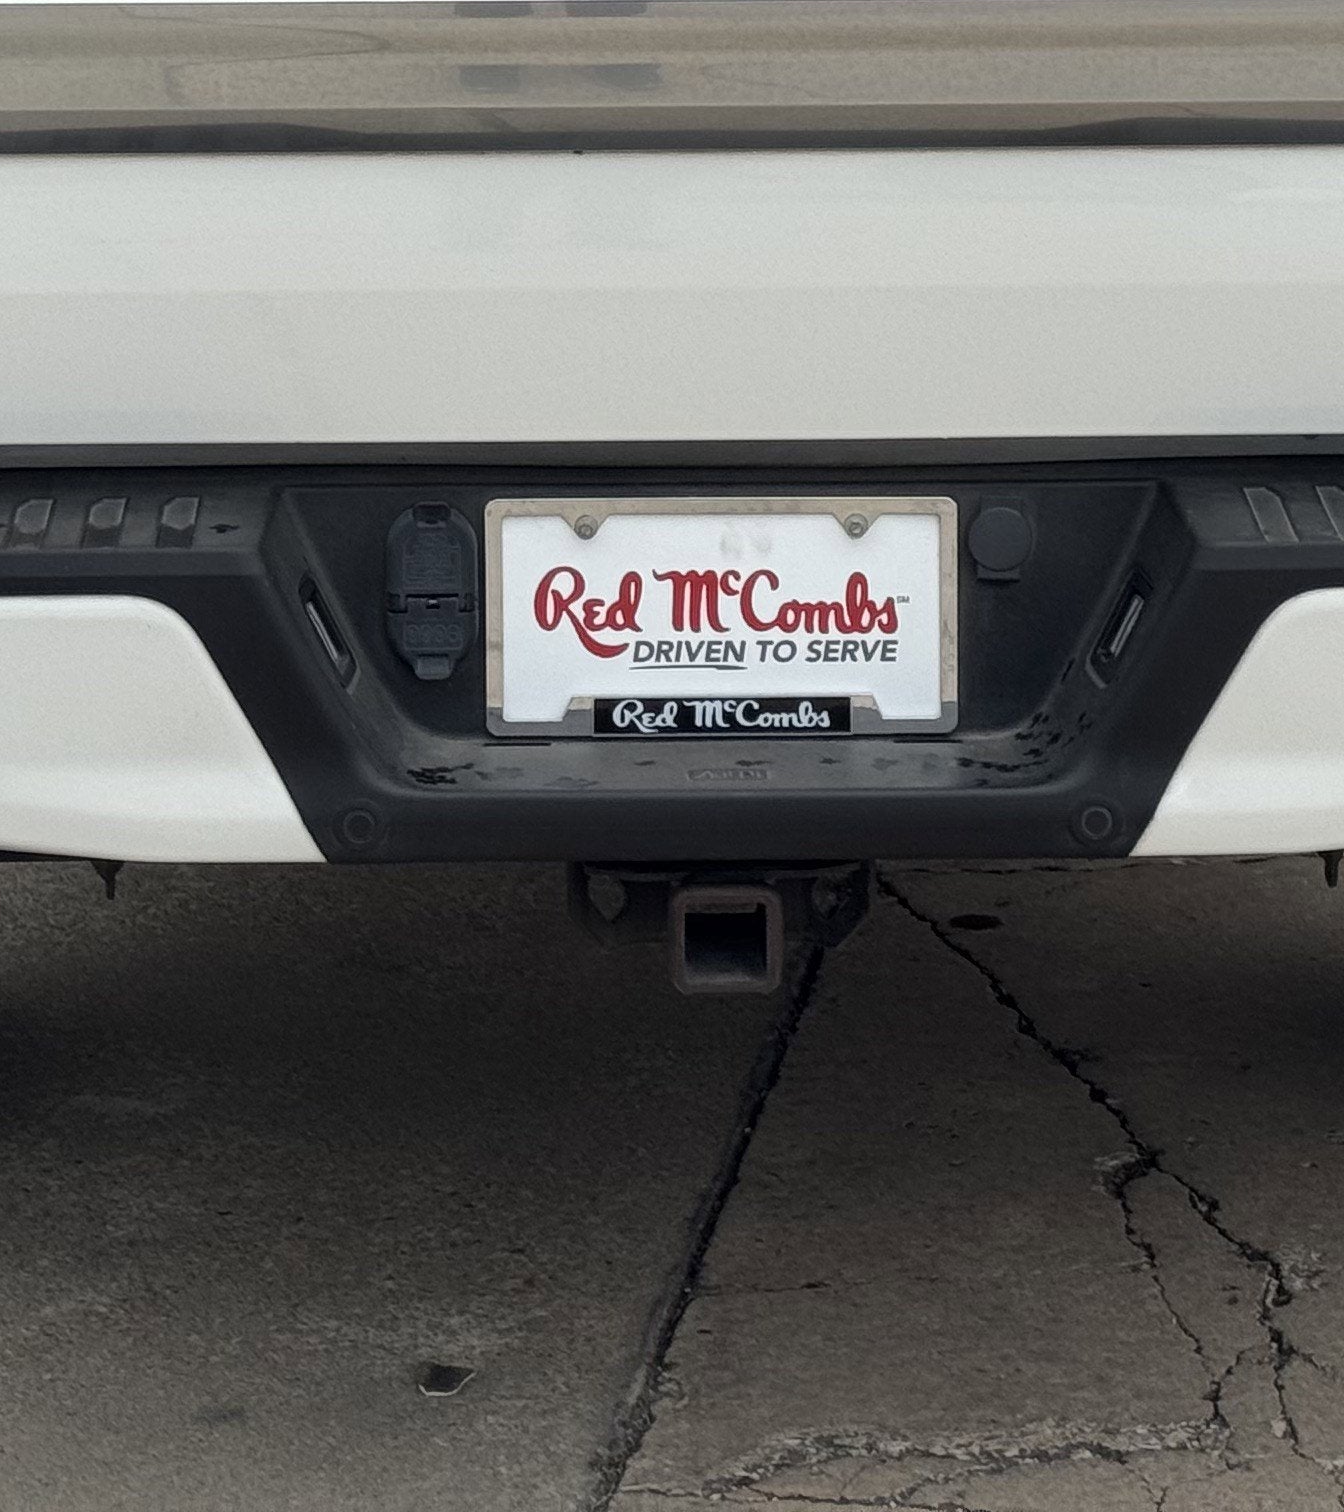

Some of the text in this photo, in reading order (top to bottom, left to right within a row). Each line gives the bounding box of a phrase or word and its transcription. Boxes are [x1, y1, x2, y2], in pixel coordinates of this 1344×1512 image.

[533, 566, 644, 659] Red
[652, 568, 900, 635] McCombs
[632, 639, 899, 664] DRIVEN TO SERVE
[612, 699, 831, 734] Red McCombs
